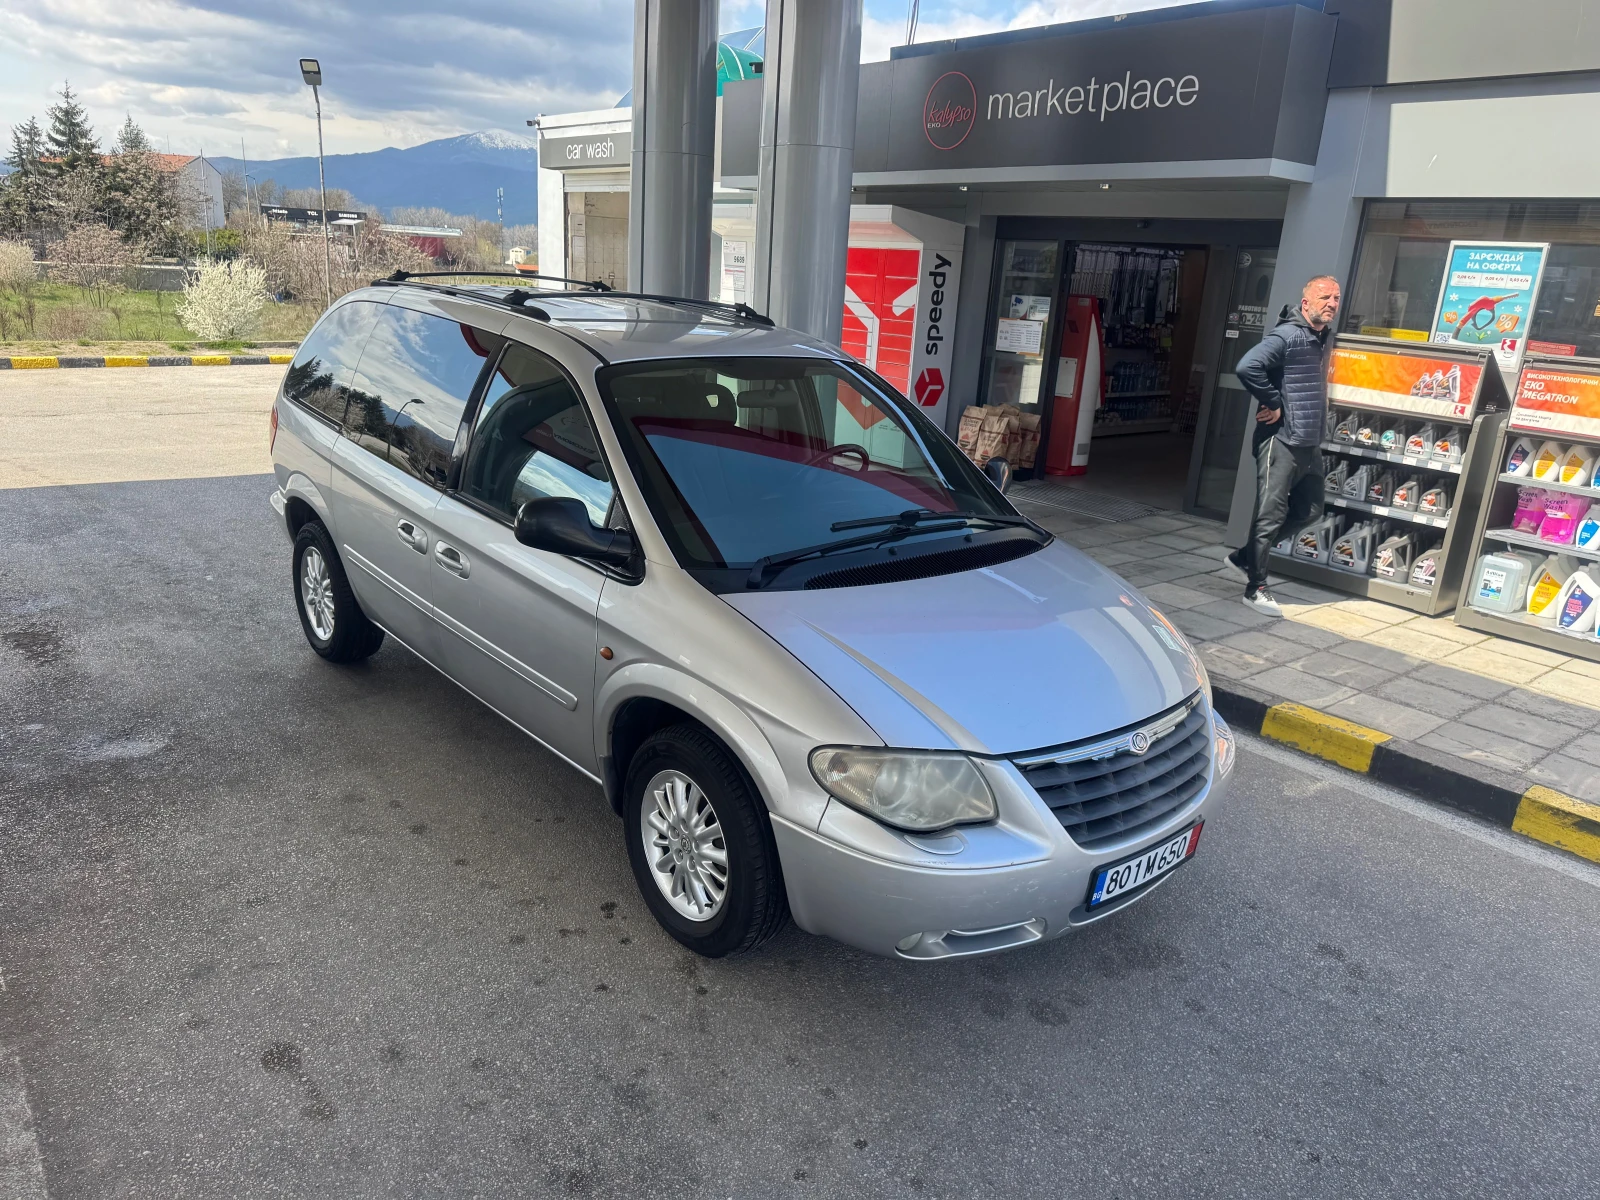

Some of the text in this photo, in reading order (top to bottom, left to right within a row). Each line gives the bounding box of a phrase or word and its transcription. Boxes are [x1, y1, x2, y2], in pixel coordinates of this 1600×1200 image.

[928, 99, 972, 128] kalypso
[566, 137, 615, 160] car wash
[1466, 262, 1522, 272] НА ОФЕРТА
[925, 252, 952, 356] speedy
[1526, 373, 1598, 385] ВИСОКОТЕХНОЛОГИЧНИ
[1524, 381, 1544, 390] EKO
[1522, 390, 1579, 404] MEGATRON
[1518, 489, 1538, 498] Screen
[1544, 503, 1563, 511] Wash
[1092, 891, 1102, 900] BG
